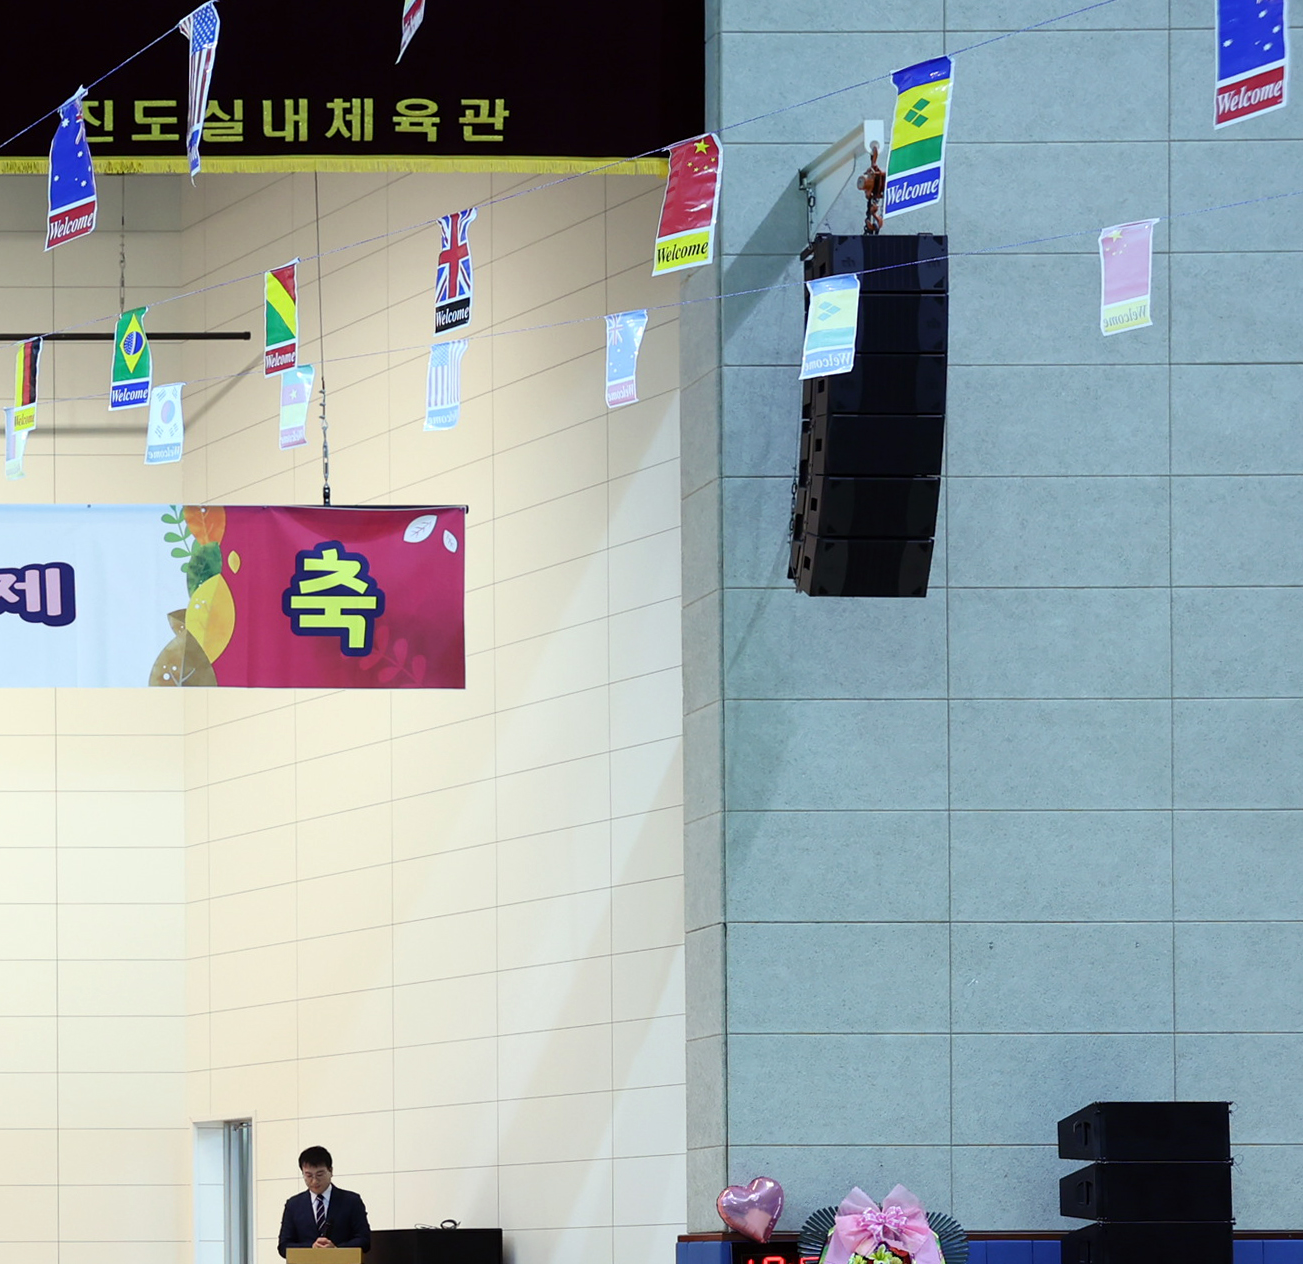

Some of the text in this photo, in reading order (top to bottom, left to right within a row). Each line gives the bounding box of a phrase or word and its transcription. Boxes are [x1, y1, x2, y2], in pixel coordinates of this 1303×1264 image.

[1216, 80, 1282, 115] Welcome
[886, 178, 939, 206] Welcome
[50, 213, 92, 239] Welcome
[657, 240, 708, 264] Welcome
[436, 304, 470, 326] Welcome
[112, 386, 148, 403] Welcome
[289, 549, 380, 650] 축
